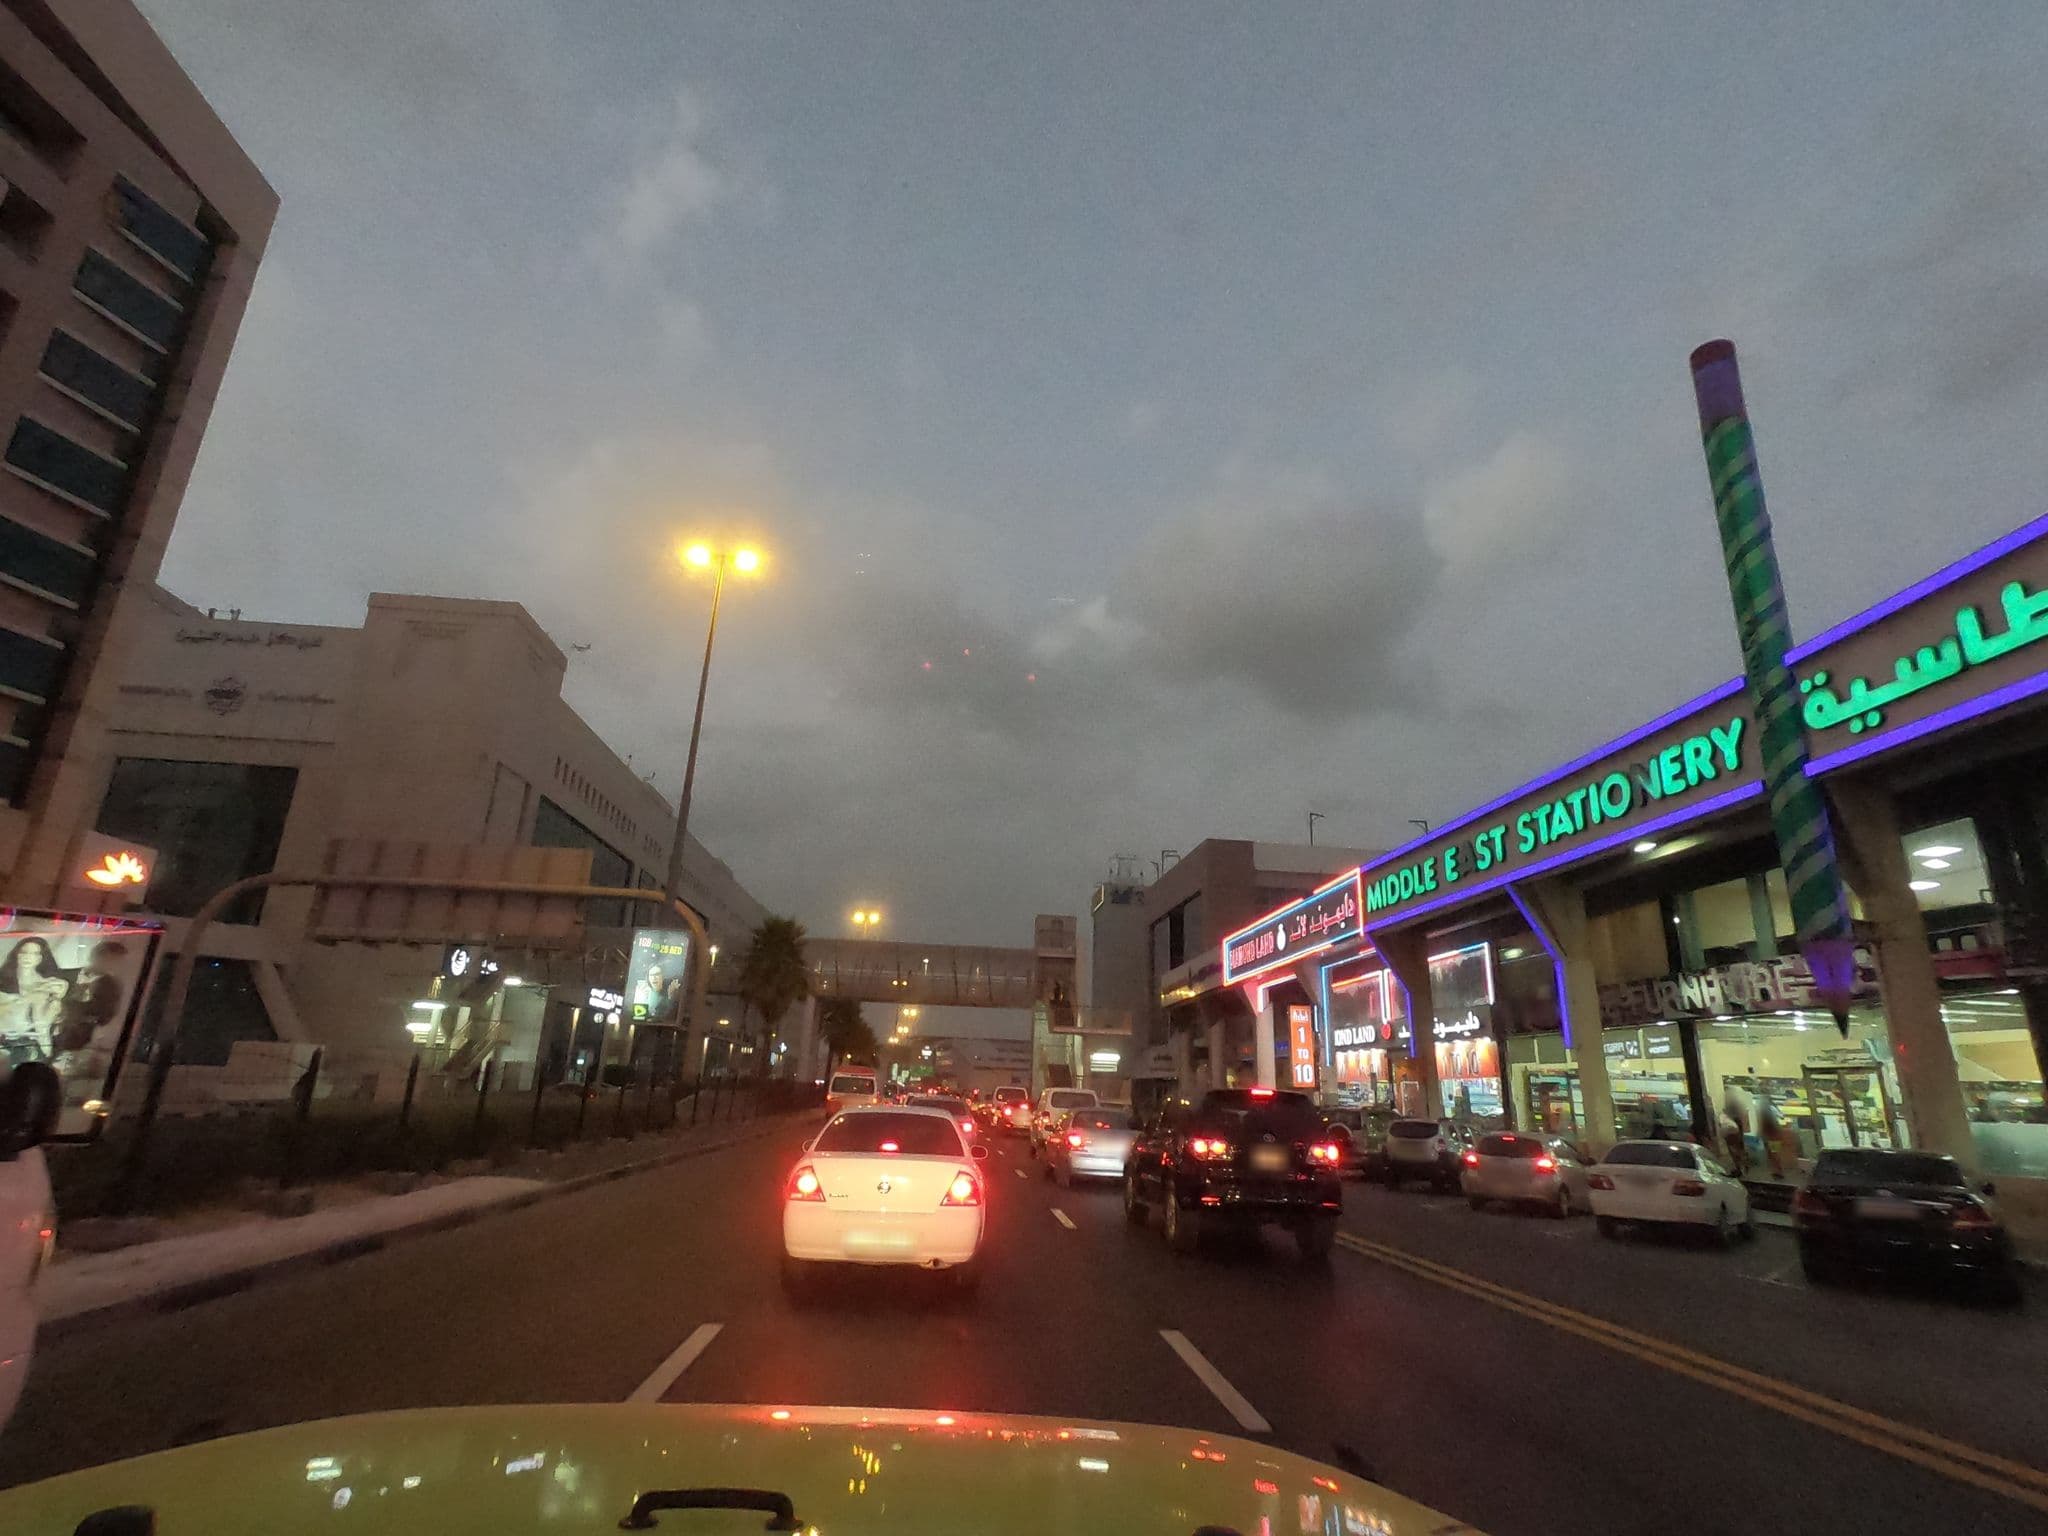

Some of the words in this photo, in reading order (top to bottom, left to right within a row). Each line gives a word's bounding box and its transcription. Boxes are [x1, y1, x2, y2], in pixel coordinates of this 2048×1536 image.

[1366, 857, 1438, 914] MIDDLE
[1444, 823, 1506, 882] EAST
[1515, 717, 1746, 853] STATIONERY
[1297, 1026, 1306, 1044] 1
[1352, 1025, 1375, 1044] LAND
[1296, 1048, 1309, 1060] TO
[1295, 1063, 1313, 1084] 10
